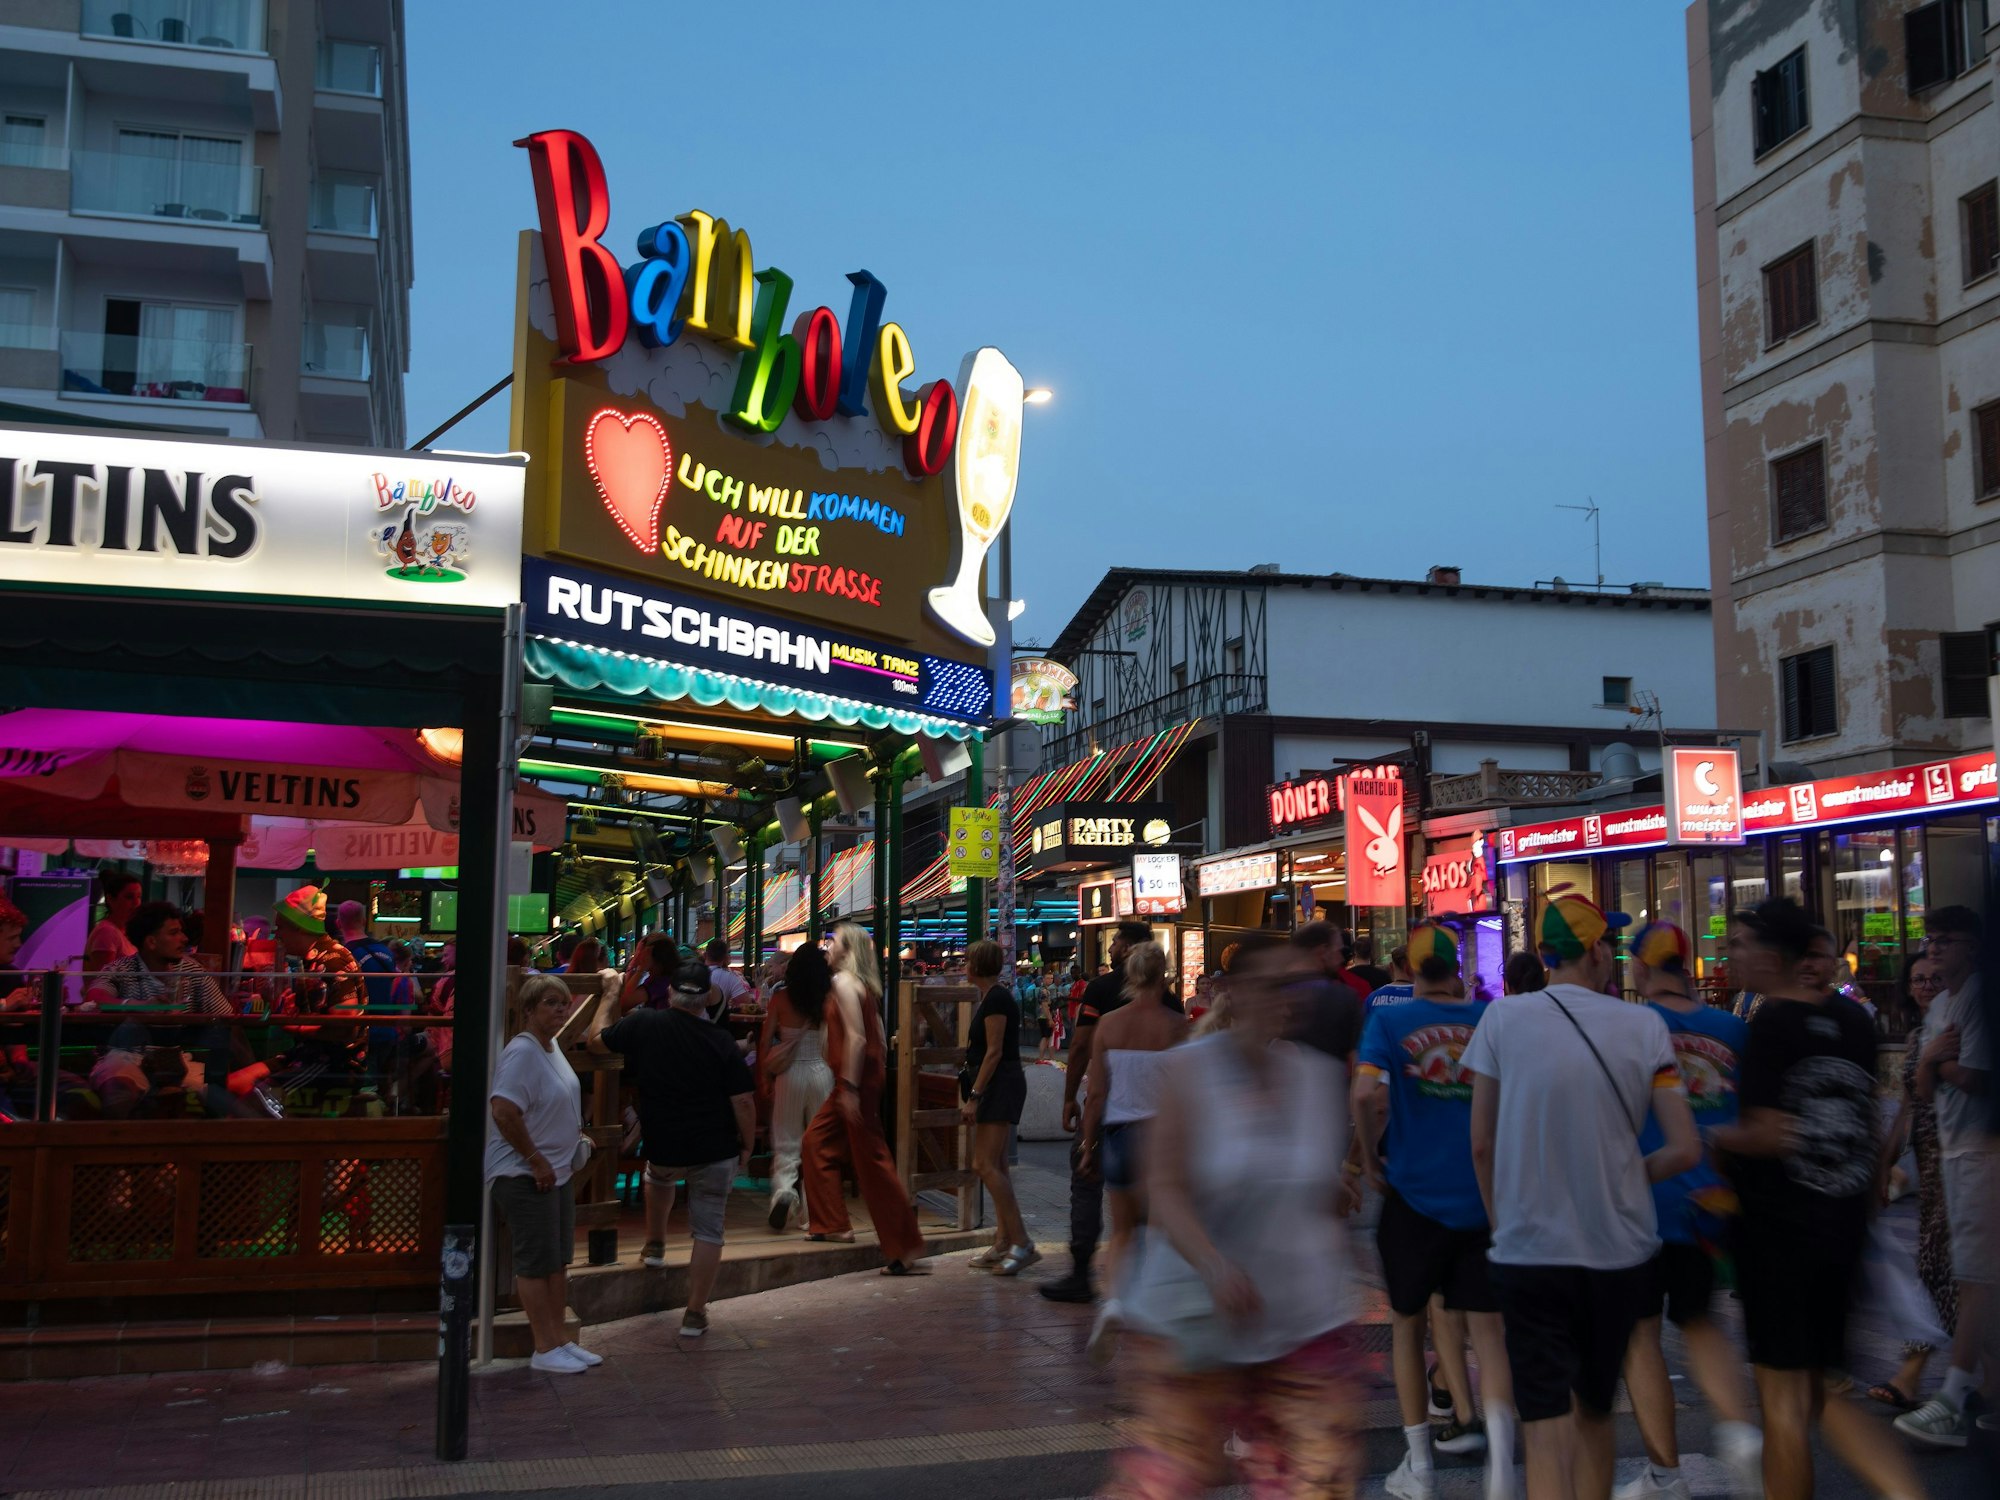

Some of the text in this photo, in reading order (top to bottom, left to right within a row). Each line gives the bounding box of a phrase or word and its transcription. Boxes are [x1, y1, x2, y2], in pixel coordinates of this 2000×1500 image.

[513, 129, 957, 476] Bamboleo
[372, 472, 477, 511] Bamboleo
[677, 453, 906, 537] LICH WILLKOMMEN
[716, 513, 820, 556] AUF DER
[547, 575, 830, 674] RUTSCHBAHN
[832, 643, 919, 677] MUSIK TANZ
[219, 770, 361, 808] VELTINS
[1270, 779, 1331, 826] DÖNER
[1353, 780, 1398, 796] NACHTCLUB
[1821, 779, 1914, 808] wurstmeister
[1685, 800, 1730, 815] wurst
[1073, 817, 1135, 833] PARTY
[1073, 832, 1135, 846] KELLER
[1518, 828, 1578, 851] grillmeister
[1681, 817, 1737, 832] meister
[1149, 879, 1163, 889] 50
[1423, 861, 1468, 894] SAFOS
